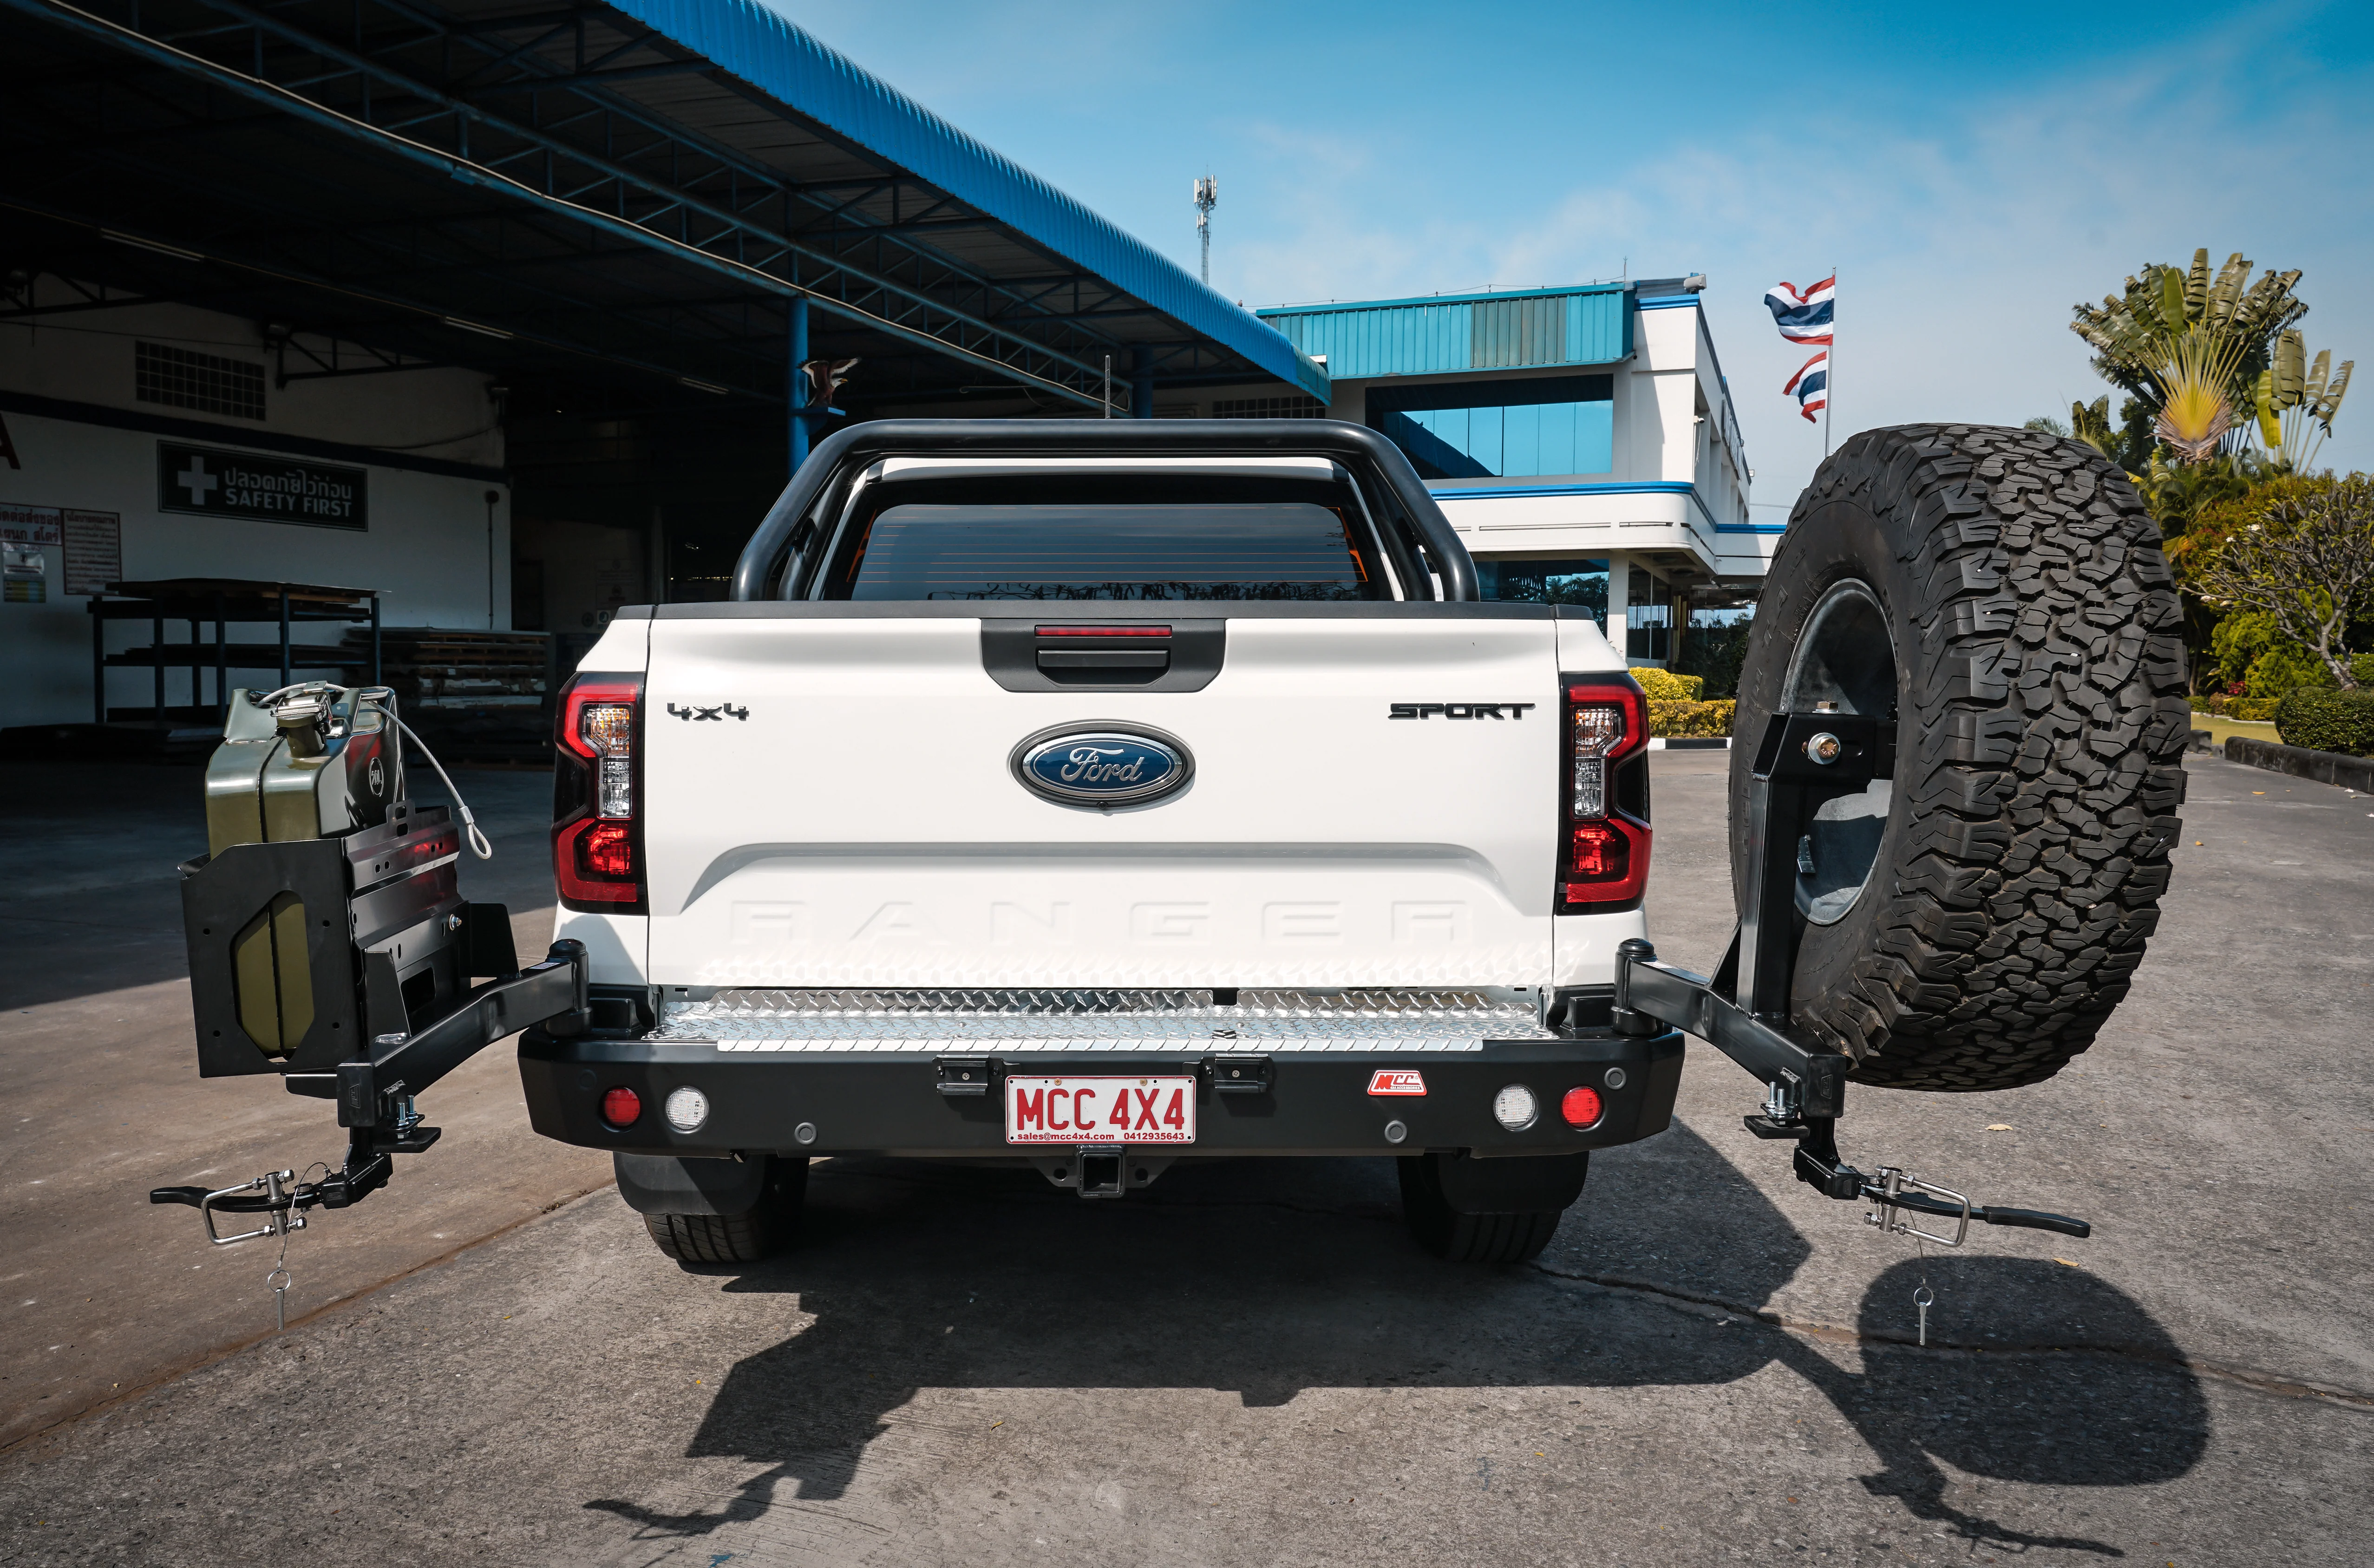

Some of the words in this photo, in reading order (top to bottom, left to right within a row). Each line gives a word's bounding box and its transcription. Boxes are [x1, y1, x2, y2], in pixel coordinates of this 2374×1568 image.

[225, 467, 352, 500] ปลอดภัยไว้ก่อน
[0, 507, 59, 525] ดต่อส่งของ
[225, 488, 295, 510] SAFETY
[303, 497, 352, 517] FIRST
[1388, 703, 1536, 720] SPORT
[1061, 747, 1145, 782] Ford
[729, 899, 1475, 946] RANGER
[1374, 1074, 1421, 1090] MCC
[1017, 1088, 1095, 1130] MCC
[1109, 1088, 1184, 1130] 4X4
[1017, 1132, 1114, 1141] sales@mcc4x4.com
